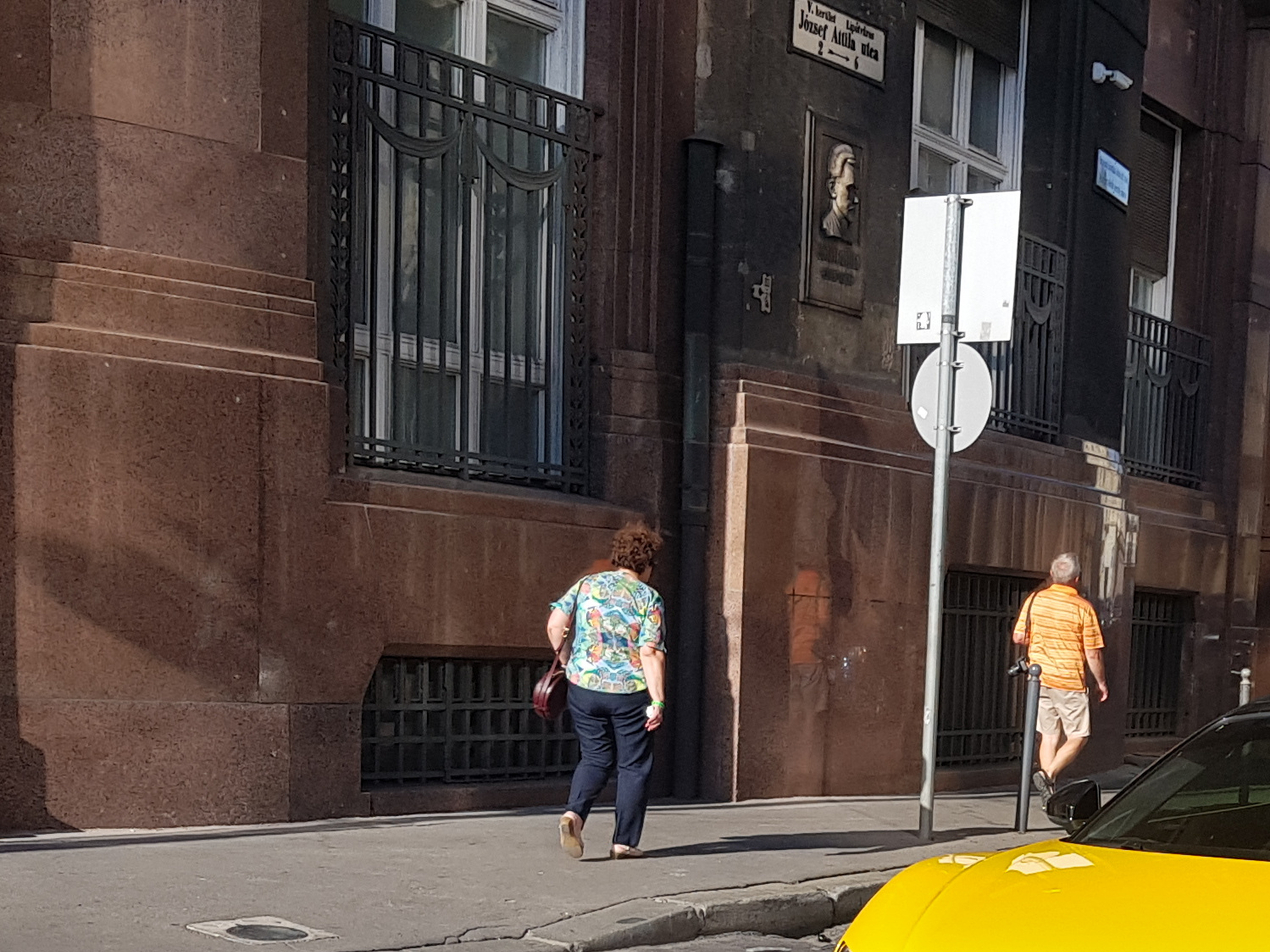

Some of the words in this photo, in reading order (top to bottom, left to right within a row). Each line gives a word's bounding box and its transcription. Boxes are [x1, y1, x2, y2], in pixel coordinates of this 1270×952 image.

[807, 0, 814, 15] V.
[798, 9, 829, 41] József
[831, 25, 856, 52] Attila
[861, 41, 879, 62] utca
[818, 40, 824, 56] 2
[854, 56, 859, 70] 6
